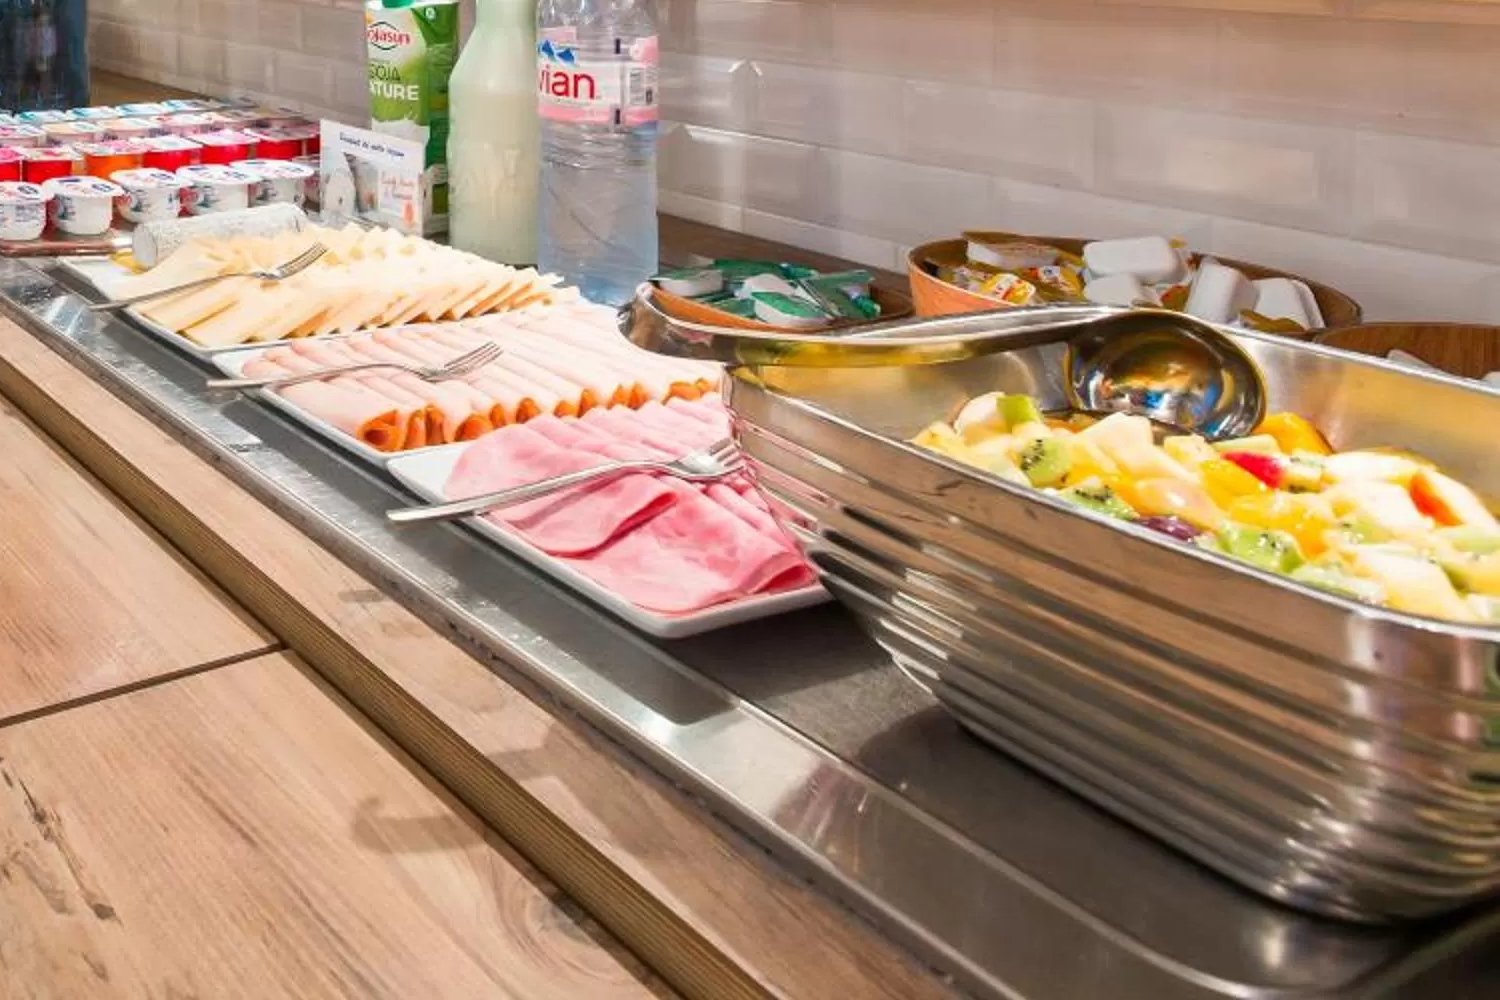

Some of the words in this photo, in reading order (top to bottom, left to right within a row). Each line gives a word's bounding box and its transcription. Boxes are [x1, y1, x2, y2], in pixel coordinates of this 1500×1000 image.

[367, 27, 411, 46] ojasun
[368, 80, 420, 101] ATURE
[539, 63, 595, 100] vian
